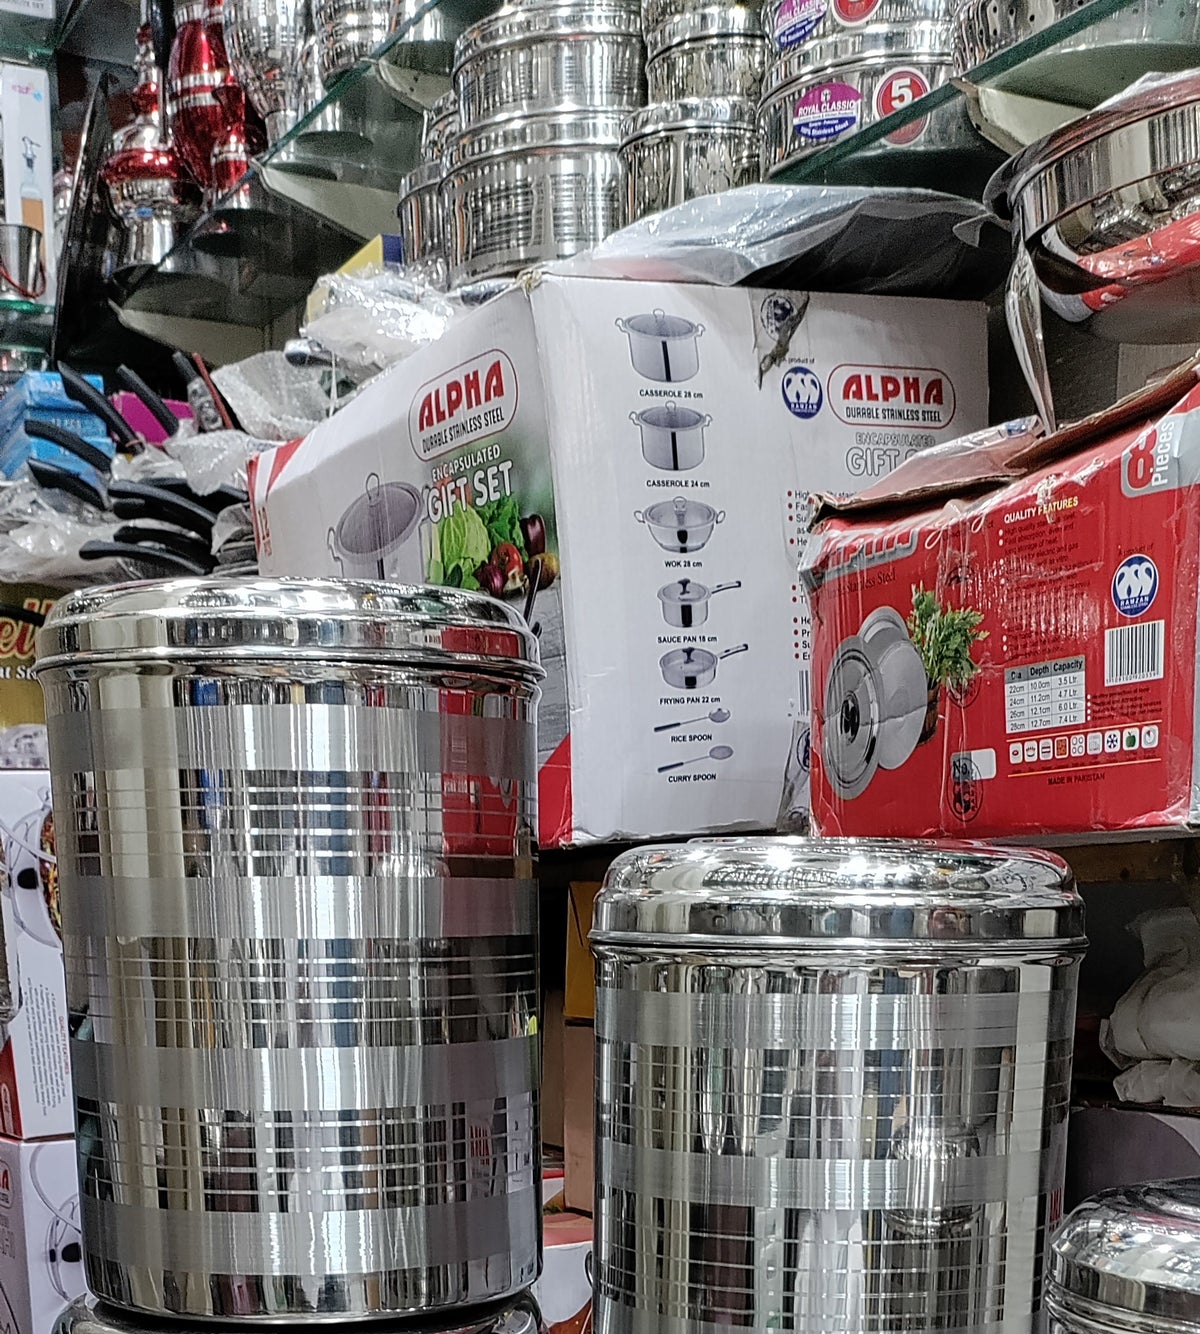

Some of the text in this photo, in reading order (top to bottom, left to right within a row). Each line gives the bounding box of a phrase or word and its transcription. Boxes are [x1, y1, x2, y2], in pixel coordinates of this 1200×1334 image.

[891, 78, 913, 109] 5
[798, 103, 820, 116] ROYAL
[821, 99, 856, 112] CLASSIC
[419, 360, 504, 432] ALPHA
[639, 389, 682, 398] CASSEROLE
[843, 374, 944, 405] ALPHA
[846, 406, 942, 422] DURABLE STAINLESS STEEL
[422, 407, 505, 453] DURABLE STAINLESS STEEL
[855, 432, 936, 448] ENCAPSULATED
[1152, 421, 1175, 486] Pieces
[432, 444, 501, 482] ENCAPSULATED
[845, 446, 901, 477] GIFT
[646, 479, 689, 488] CASSEROLE
[427, 460, 513, 523] GIFT SET
[1004, 507, 1037, 524] QUALITY
[1038, 496, 1078, 516] FEATURES
[664, 560, 682, 568] WOK
[1120, 597, 1149, 606] RAMZAN
[683, 635, 697, 643] PAN
[1030, 665, 1049, 676] Depth
[1053, 660, 1083, 672] Capacity
[1009, 685, 1024, 694] 22cm
[660, 697, 685, 705] FRYING
[1009, 698, 1025, 706] 24cm
[1031, 693, 1050, 703] 11.2cm
[1031, 706, 1050, 715] 12.1cm
[1010, 723, 1025, 731] 28cm
[1031, 718, 1051, 728] 12.7cm
[689, 734, 712, 742] SPOON
[668, 773, 716, 783] CURRY SPOON
[1048, 772, 1105, 785] MADE IN PAKISTAN
